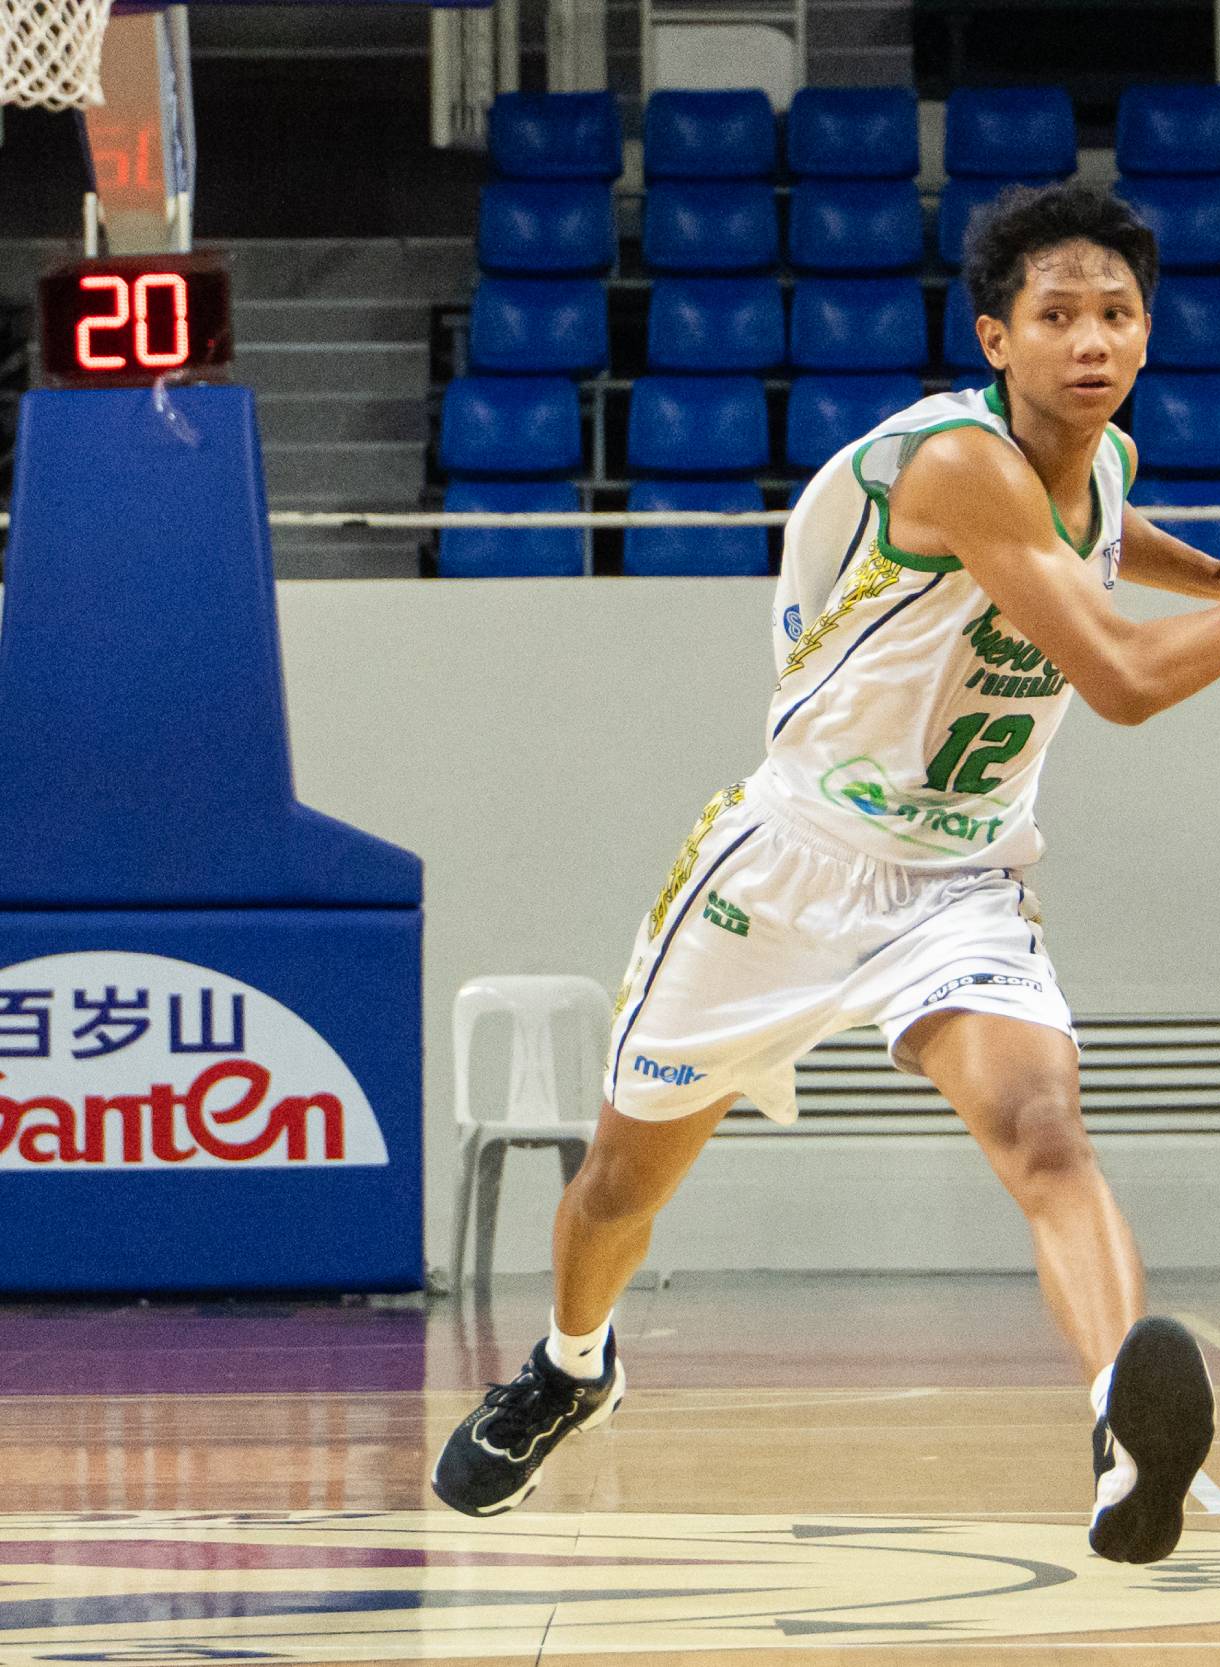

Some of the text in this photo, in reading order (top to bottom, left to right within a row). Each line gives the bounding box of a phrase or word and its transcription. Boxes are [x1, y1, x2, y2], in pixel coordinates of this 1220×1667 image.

[76, 273, 189, 371] 20
[922, 712, 1035, 793] 12
[0, 1059, 344, 1163] anten
